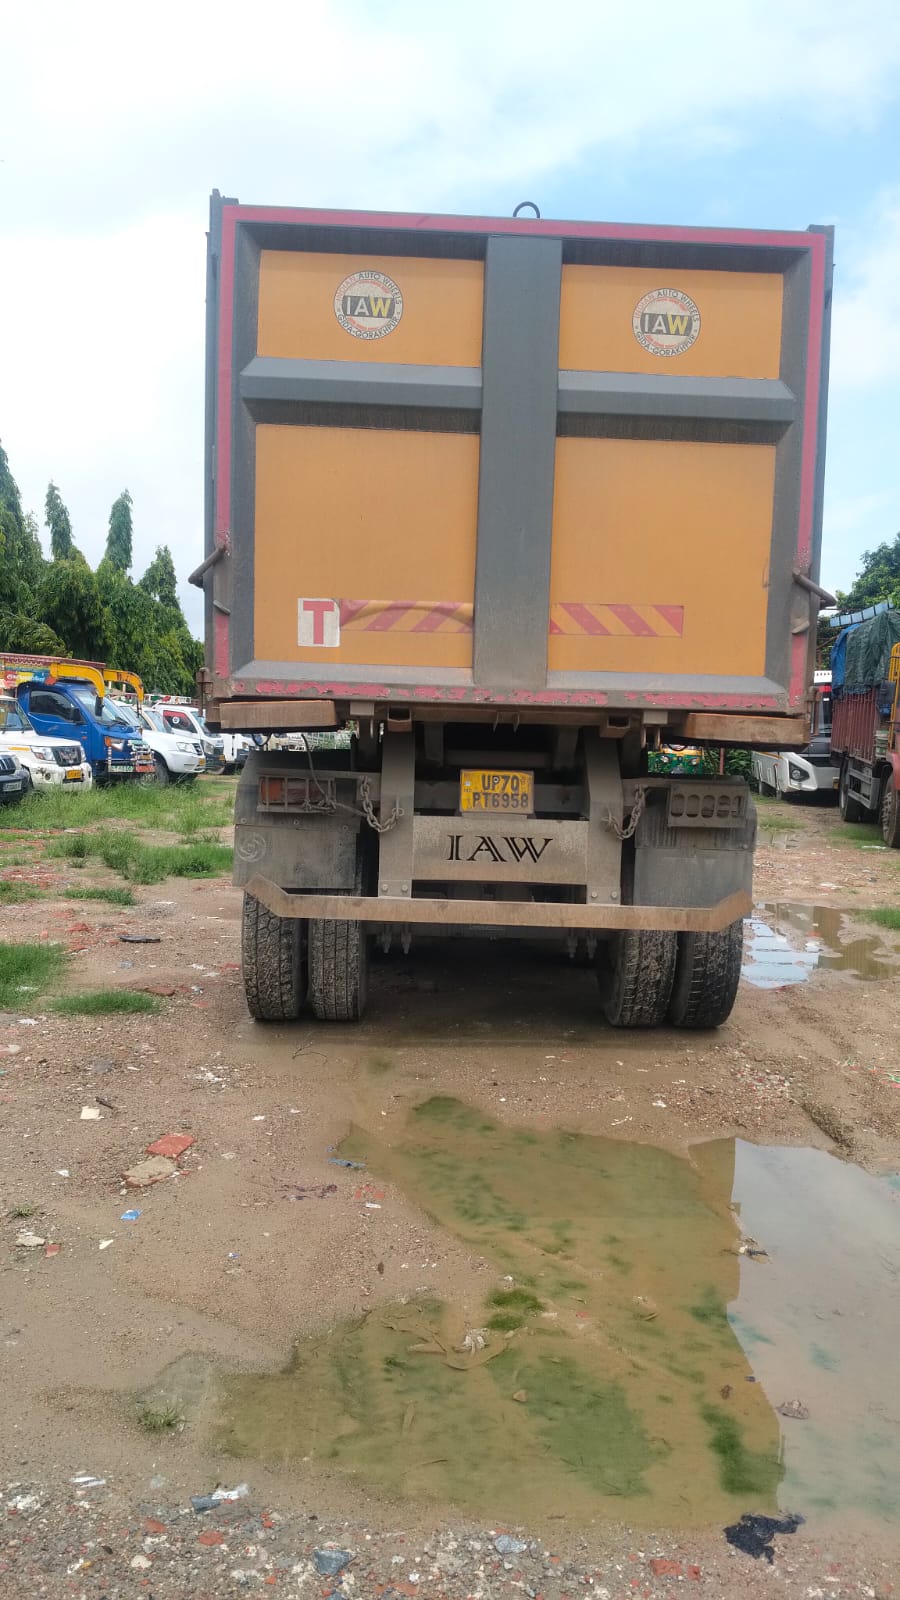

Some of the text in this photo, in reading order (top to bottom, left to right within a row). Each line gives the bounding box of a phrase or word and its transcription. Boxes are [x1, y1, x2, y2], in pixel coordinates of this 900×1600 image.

[359, 272, 381, 280] AUTO
[382, 277, 402, 305] WHEELS
[346, 295, 391, 317] IAW
[657, 289, 679, 298] AUTO
[680, 295, 700, 322] WHEELS
[644, 313, 689, 335] IAW
[303, 600, 335, 645] T
[481, 774, 520, 791] UP70
[472, 792, 529, 809] PT6958
[446, 834, 554, 864] IAW
